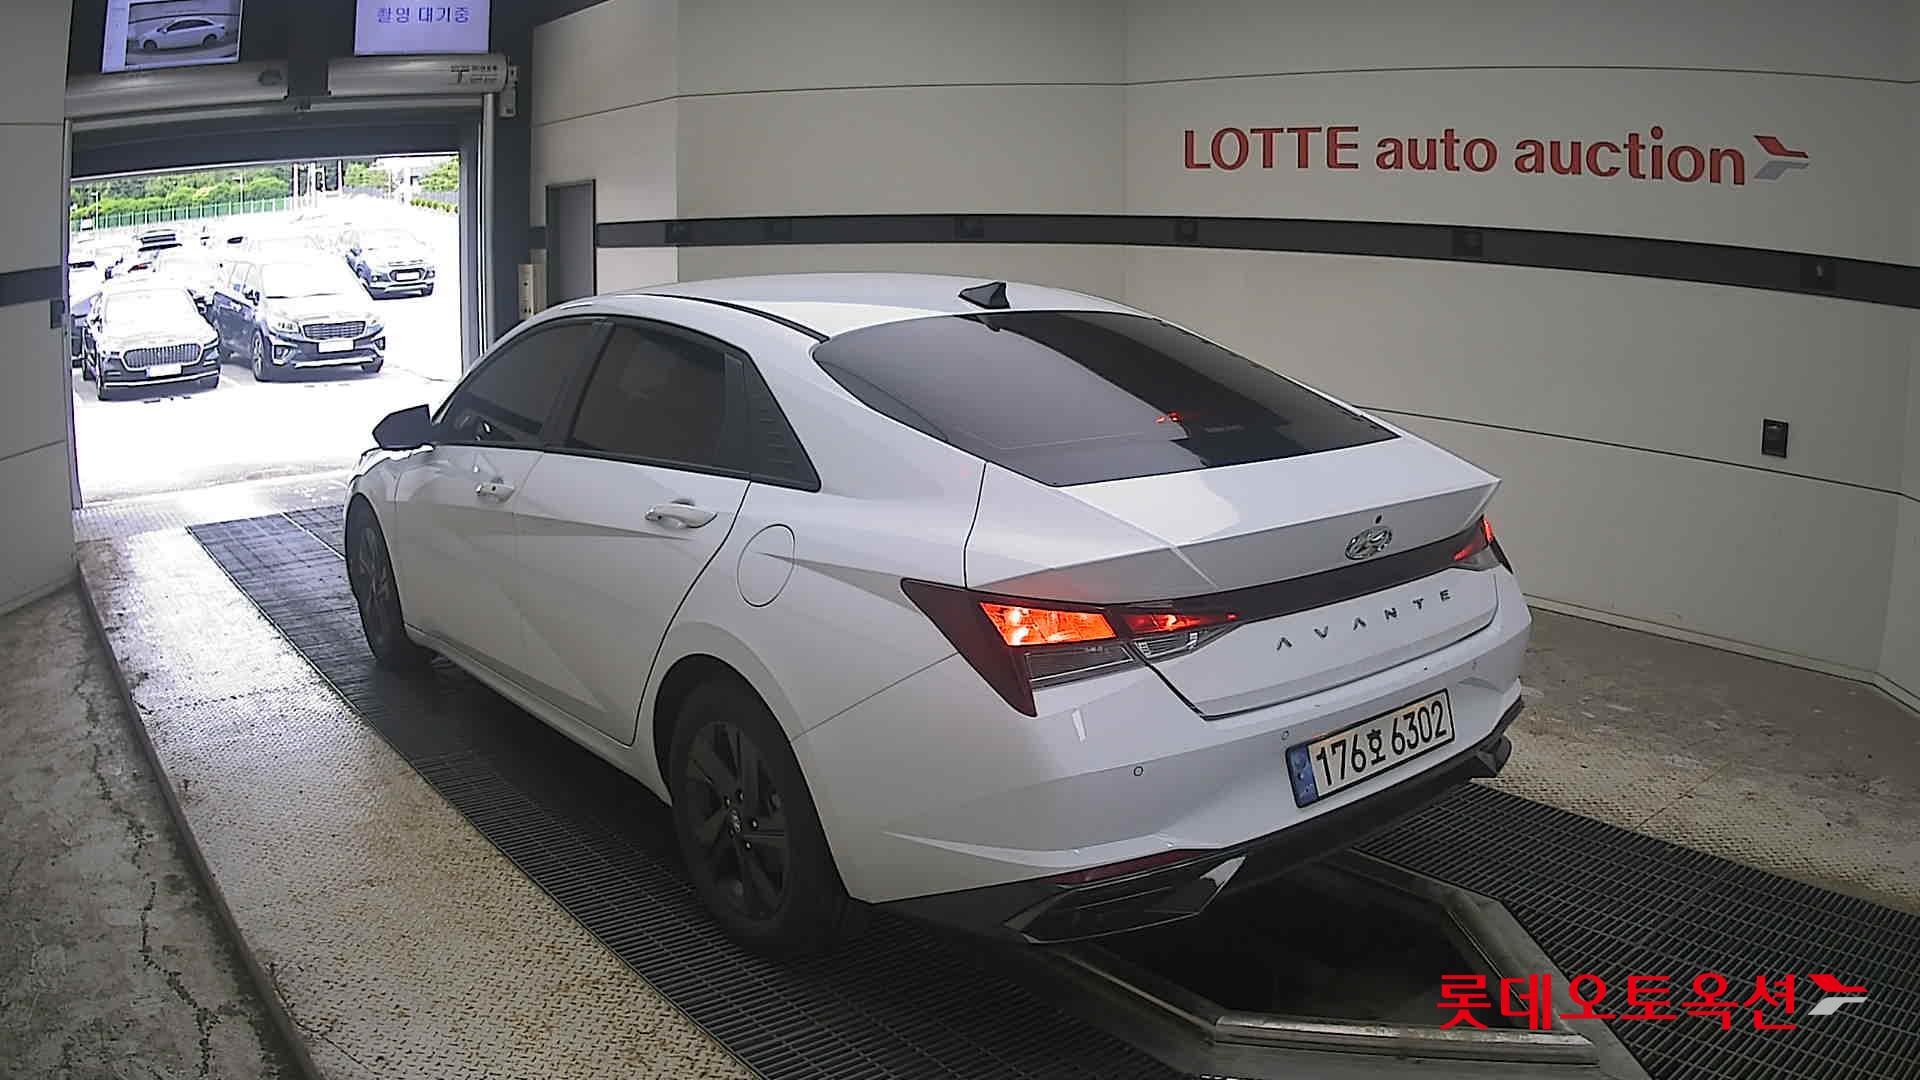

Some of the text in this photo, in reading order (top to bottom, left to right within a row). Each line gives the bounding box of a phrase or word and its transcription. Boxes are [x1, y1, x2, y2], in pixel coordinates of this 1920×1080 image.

[1184, 126, 1746, 186] LOTTE auto auction
[1276, 589, 1451, 651] AVANTE
